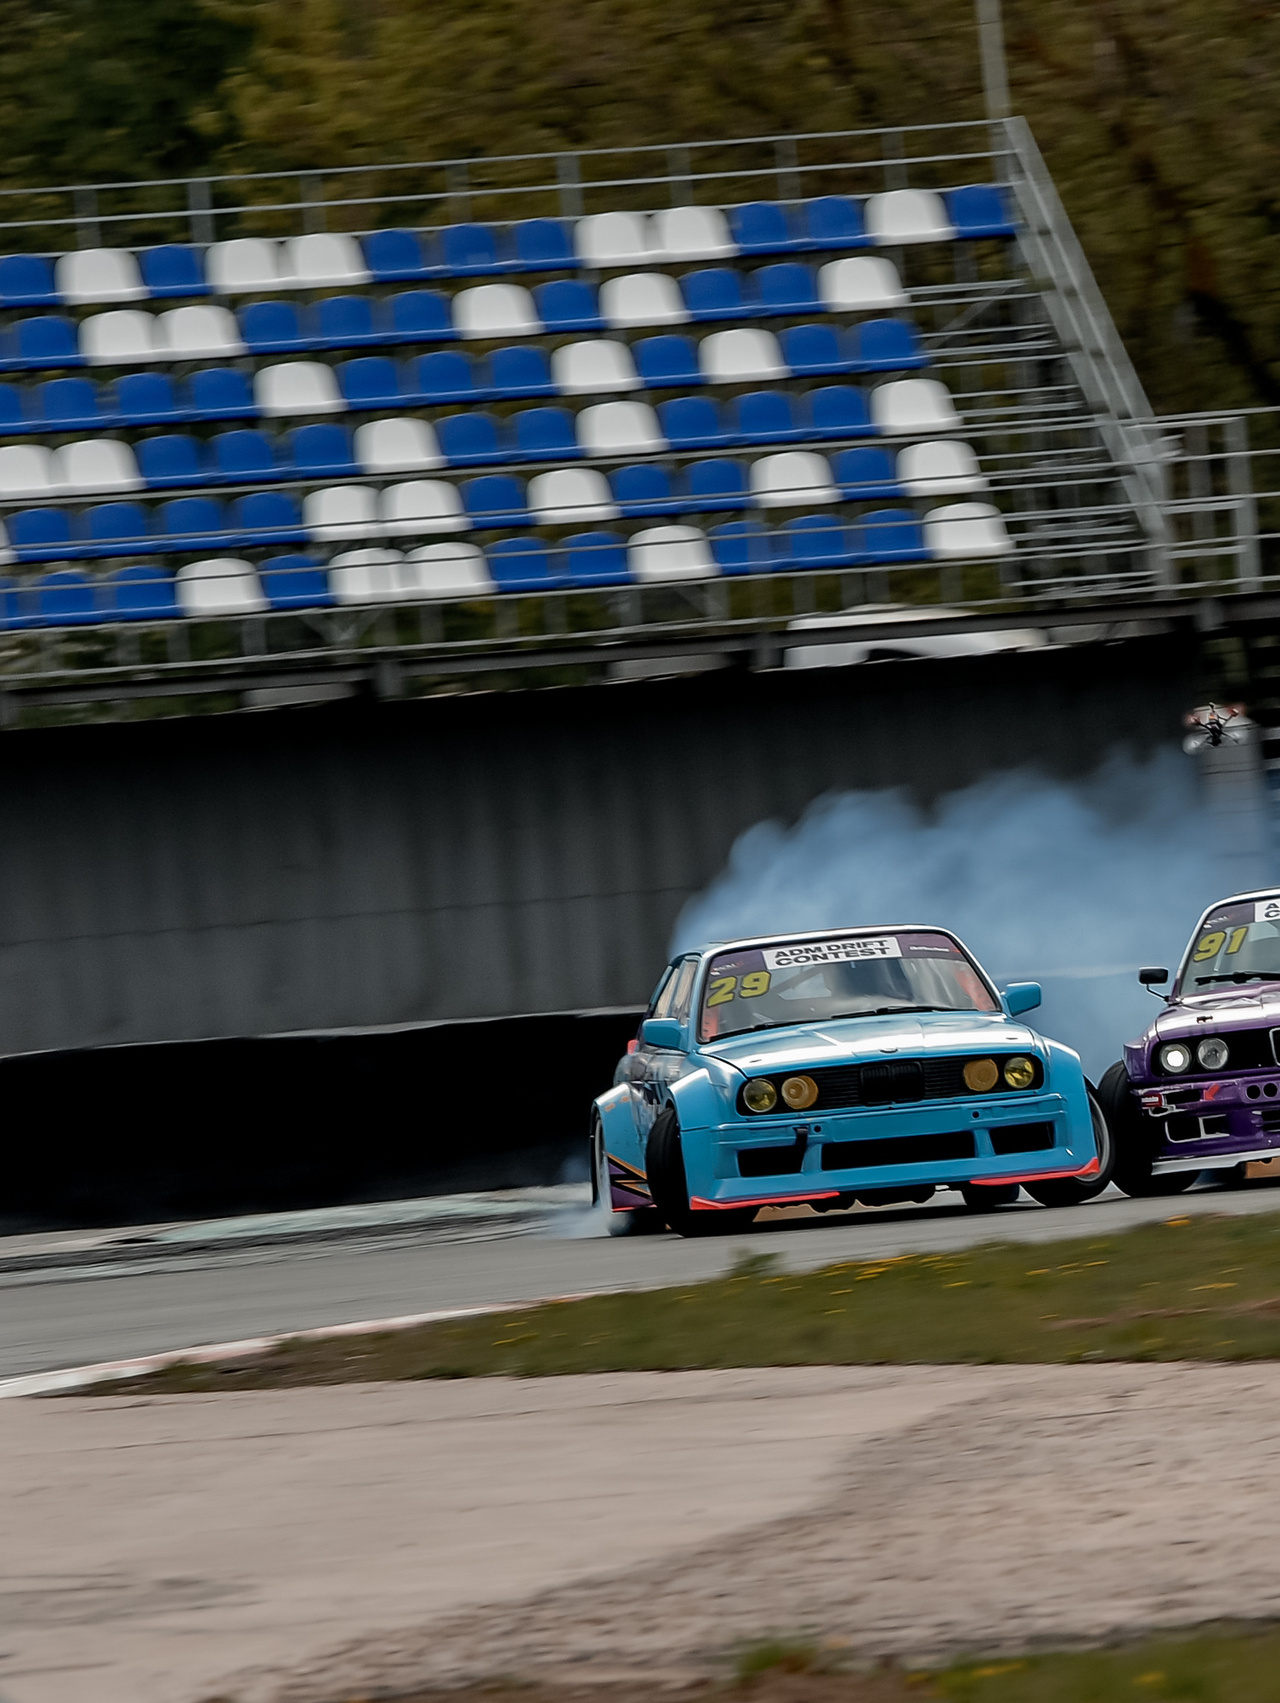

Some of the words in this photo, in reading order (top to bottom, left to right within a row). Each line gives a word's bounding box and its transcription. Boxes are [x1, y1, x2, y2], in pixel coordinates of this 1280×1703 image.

[775, 946, 823, 958] ADM
[826, 940, 888, 952] DRIFT
[775, 947, 890, 966] CONTEST
[1193, 927, 1249, 962] 91
[706, 970, 772, 1007] 29
